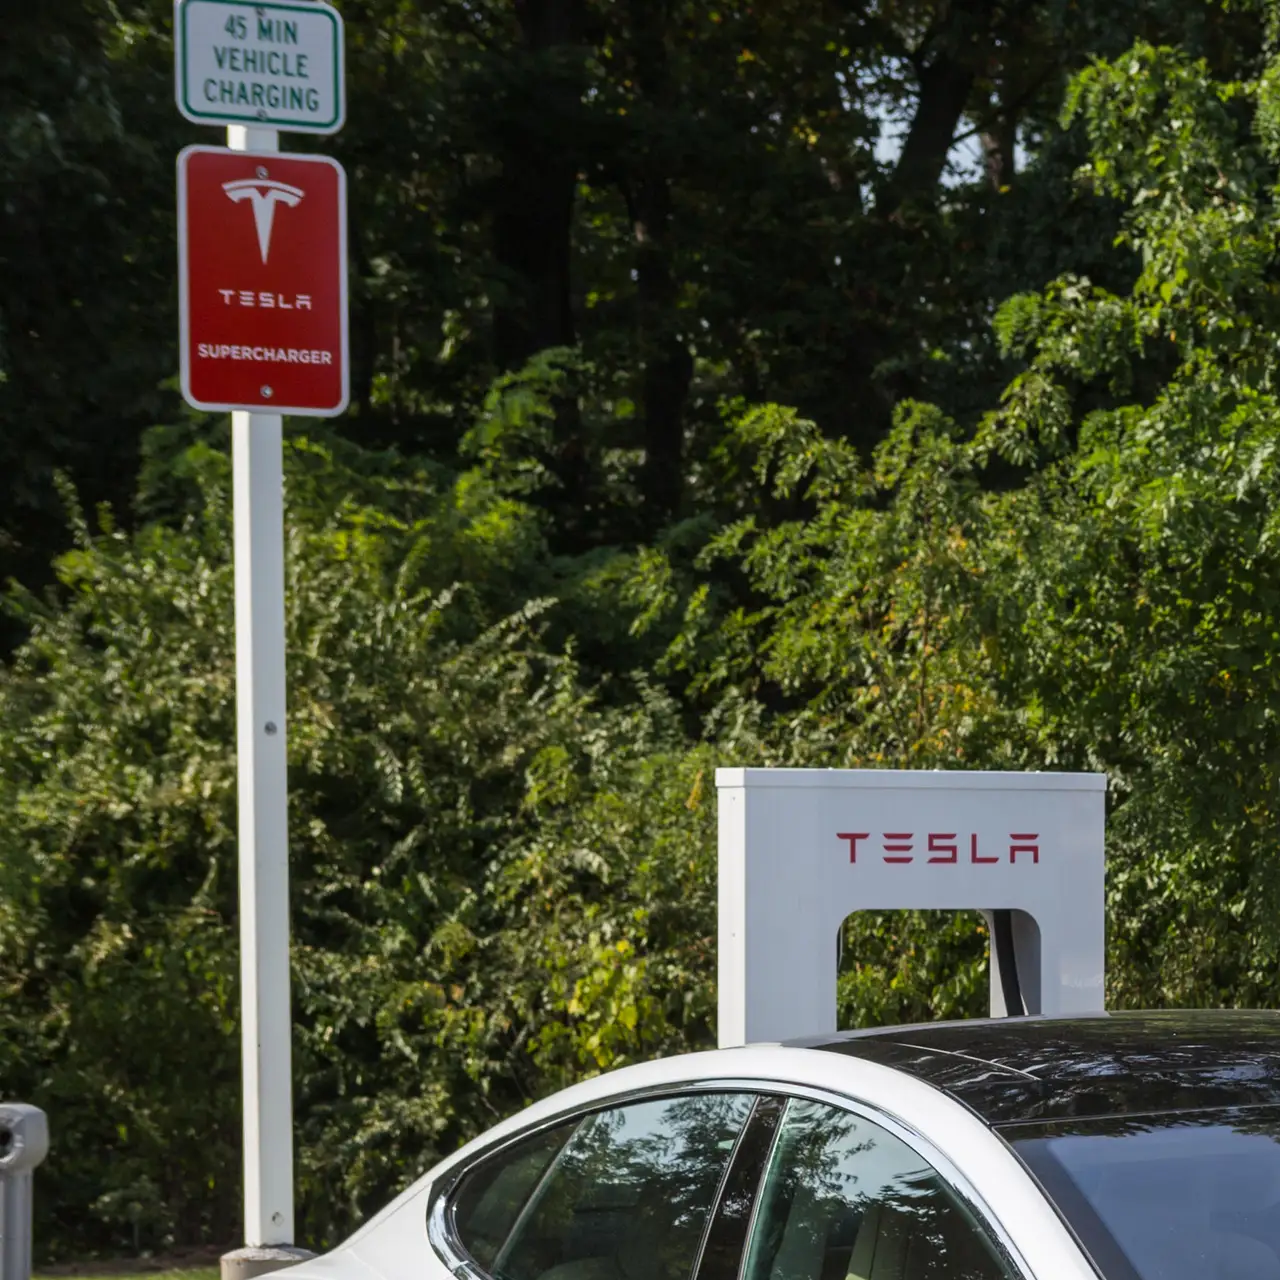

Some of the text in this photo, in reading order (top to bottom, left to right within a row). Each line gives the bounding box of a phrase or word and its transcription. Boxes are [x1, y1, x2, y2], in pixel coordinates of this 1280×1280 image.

[223, 13, 299, 45] 45 MIN
[213, 46, 309, 79] VEHICLE
[204, 79, 320, 112] CHARGING
[218, 288, 312, 311] TESLA
[198, 342, 332, 366] SUPERCHARGER
[836, 832, 1040, 864] TESLA
